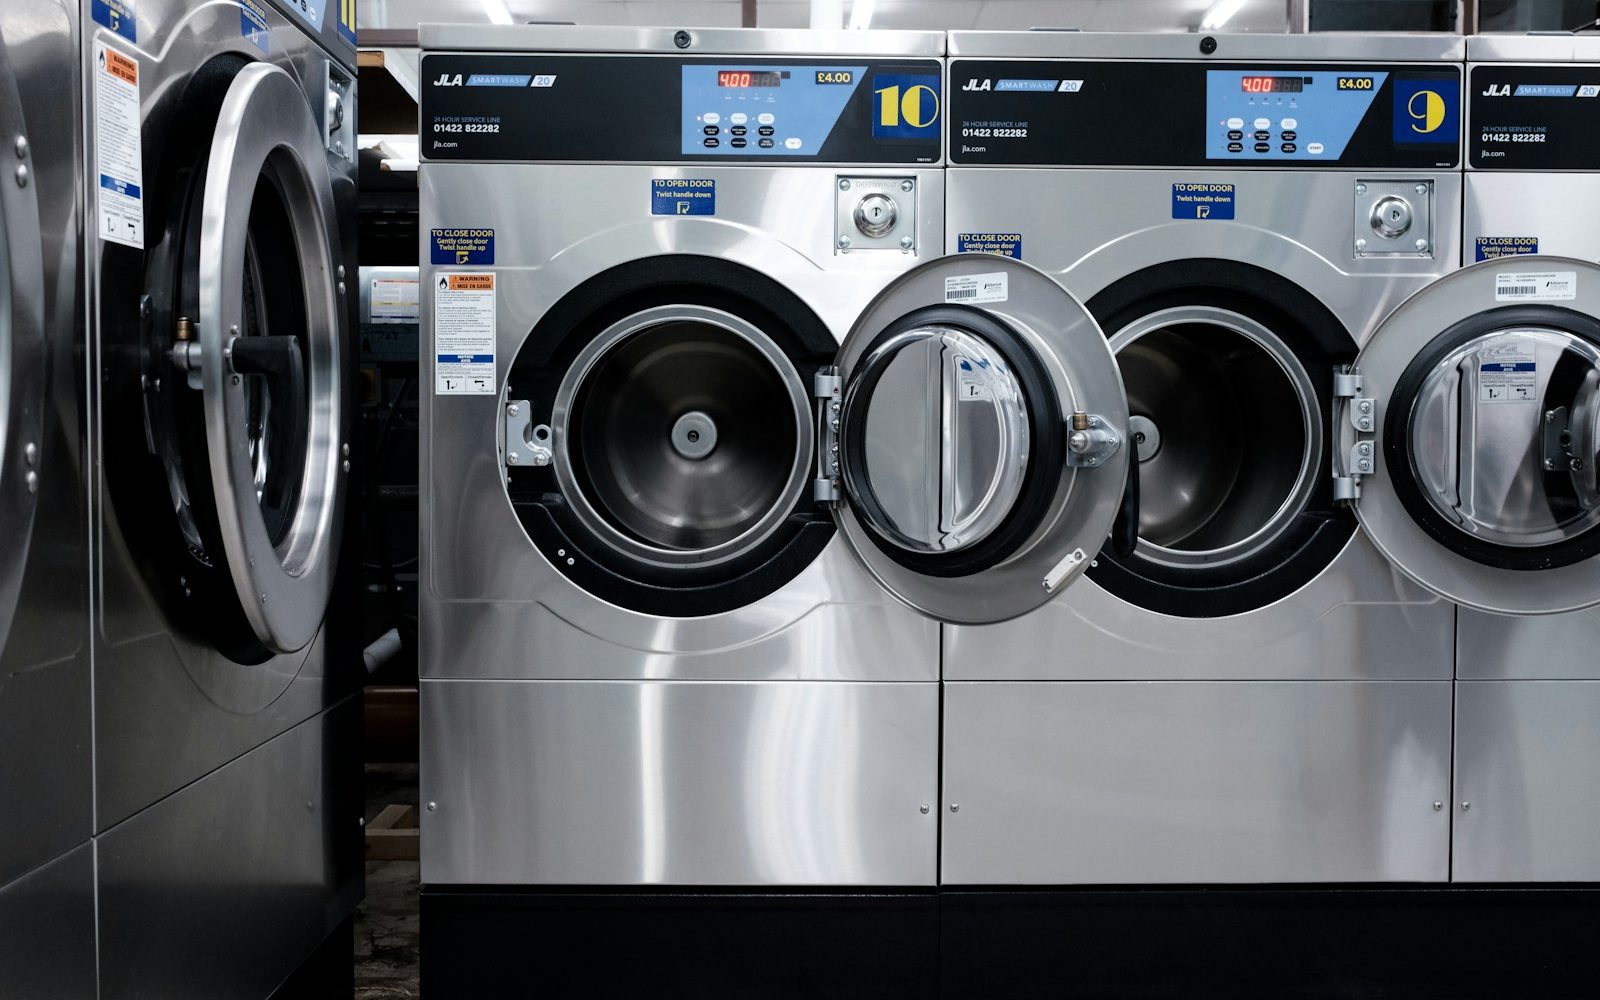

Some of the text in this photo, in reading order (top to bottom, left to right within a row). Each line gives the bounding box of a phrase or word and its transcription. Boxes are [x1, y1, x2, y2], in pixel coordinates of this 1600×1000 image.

[433, 73, 462, 86] JLA
[537, 76, 550, 86] 20
[720, 73, 750, 87] 4.00
[818, 72, 850, 82] £4.00
[962, 79, 991, 91] JLA
[1064, 82, 1077, 91] 20
[1242, 78, 1272, 92] 4.00
[1339, 79, 1371, 89] £4.00
[1483, 84, 1511, 97] JLA
[1583, 87, 1595, 95] 20
[875, 85, 939, 128] 10
[1408, 90, 1446, 133] 9
[434, 124, 499, 133] 01422 822282
[962, 128, 1027, 137] 01422 822282
[1482, 134, 1545, 142] 01422 822282
[433, 140, 458, 149] jla.com
[962, 145, 986, 153] jla.com
[1482, 150, 1505, 158] jla.com
